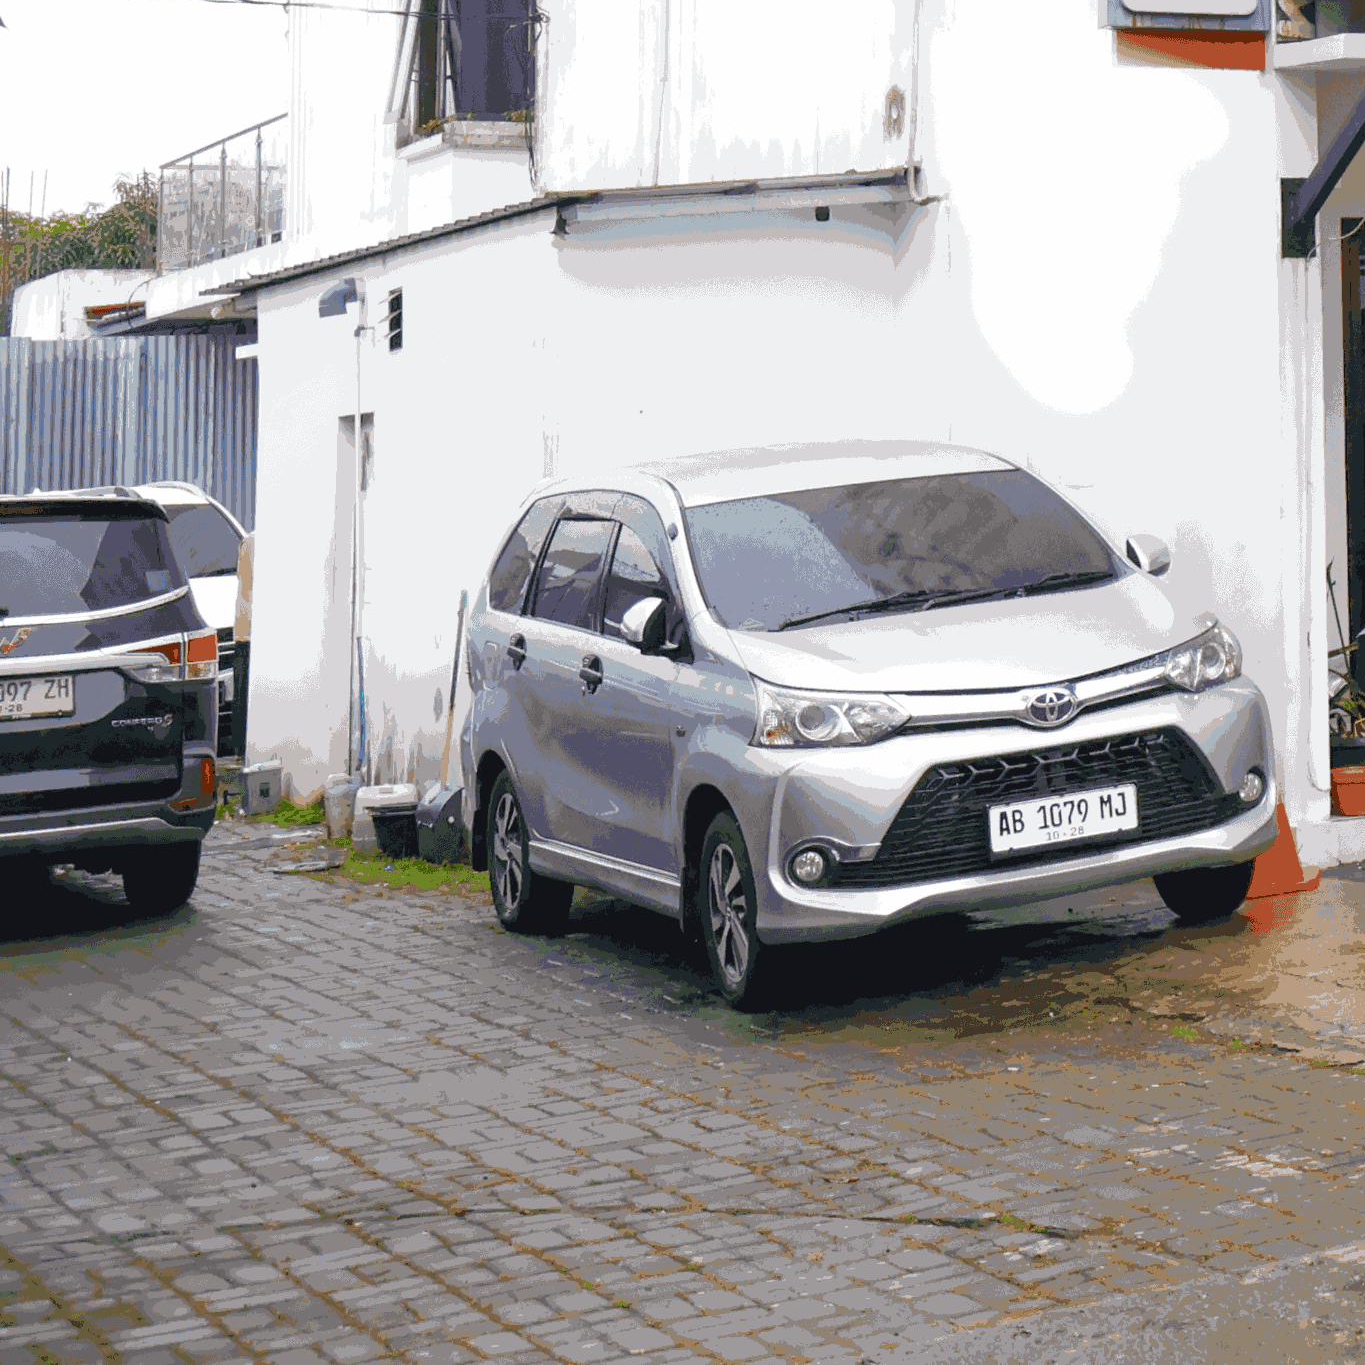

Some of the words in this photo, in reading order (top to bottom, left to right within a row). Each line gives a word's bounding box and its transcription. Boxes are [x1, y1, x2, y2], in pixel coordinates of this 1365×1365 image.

[44, 678, 70, 699] ZH
[999, 809, 1025, 836] AB
[1037, 798, 1089, 830] 1079
[1099, 791, 1127, 820] MJ
